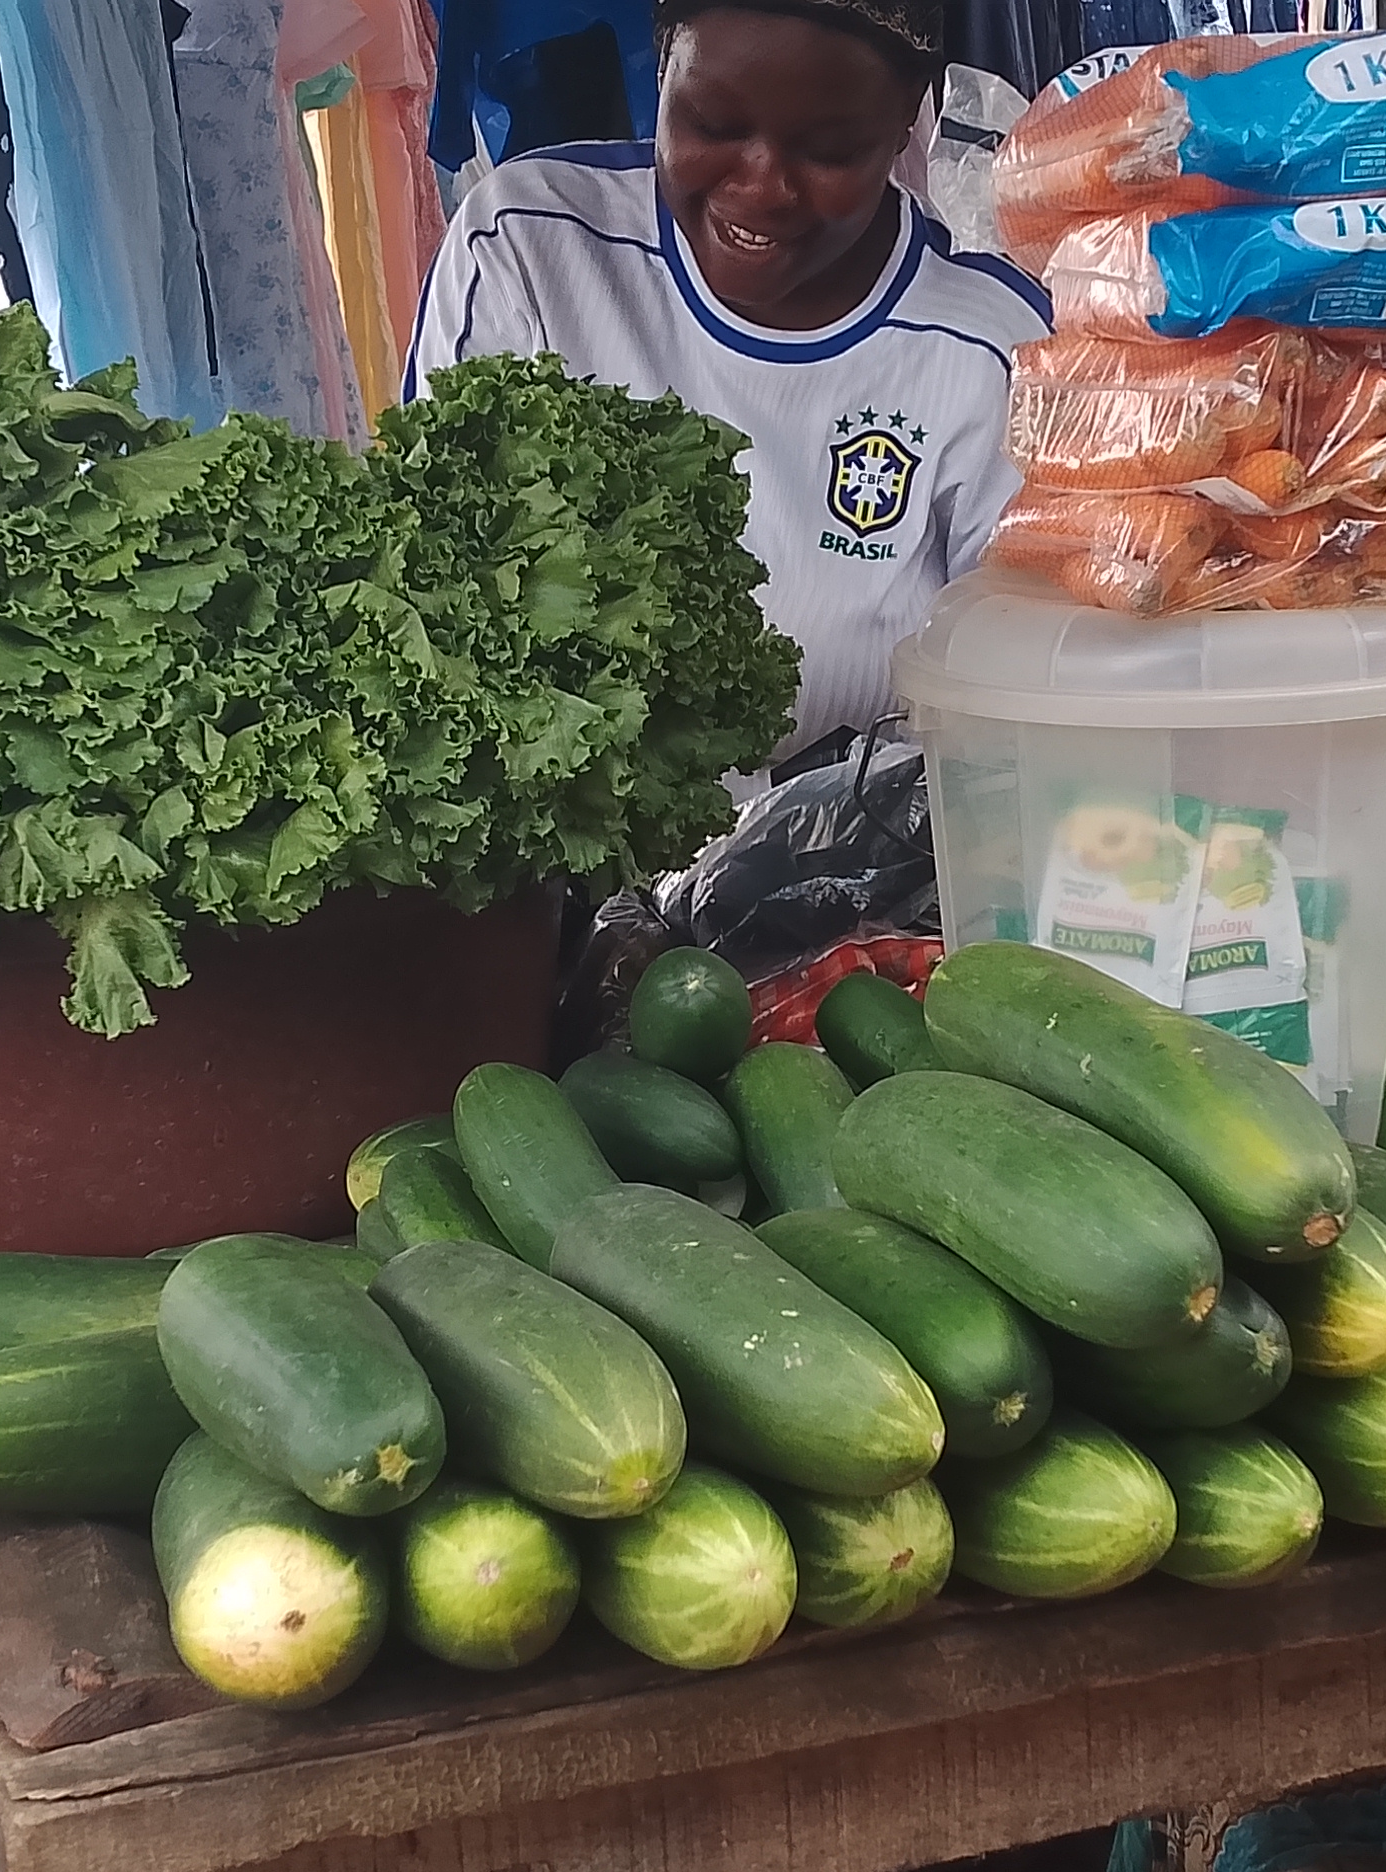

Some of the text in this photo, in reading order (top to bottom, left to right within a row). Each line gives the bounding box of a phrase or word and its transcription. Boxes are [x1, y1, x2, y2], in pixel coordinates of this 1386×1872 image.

[1333, 60, 1356, 92] 1
[1326, 204, 1348, 238] 1
[857, 472, 885, 487] CBF
[818, 530, 898, 561] BRASIL
[1054, 927, 1148, 955] AROMATE
